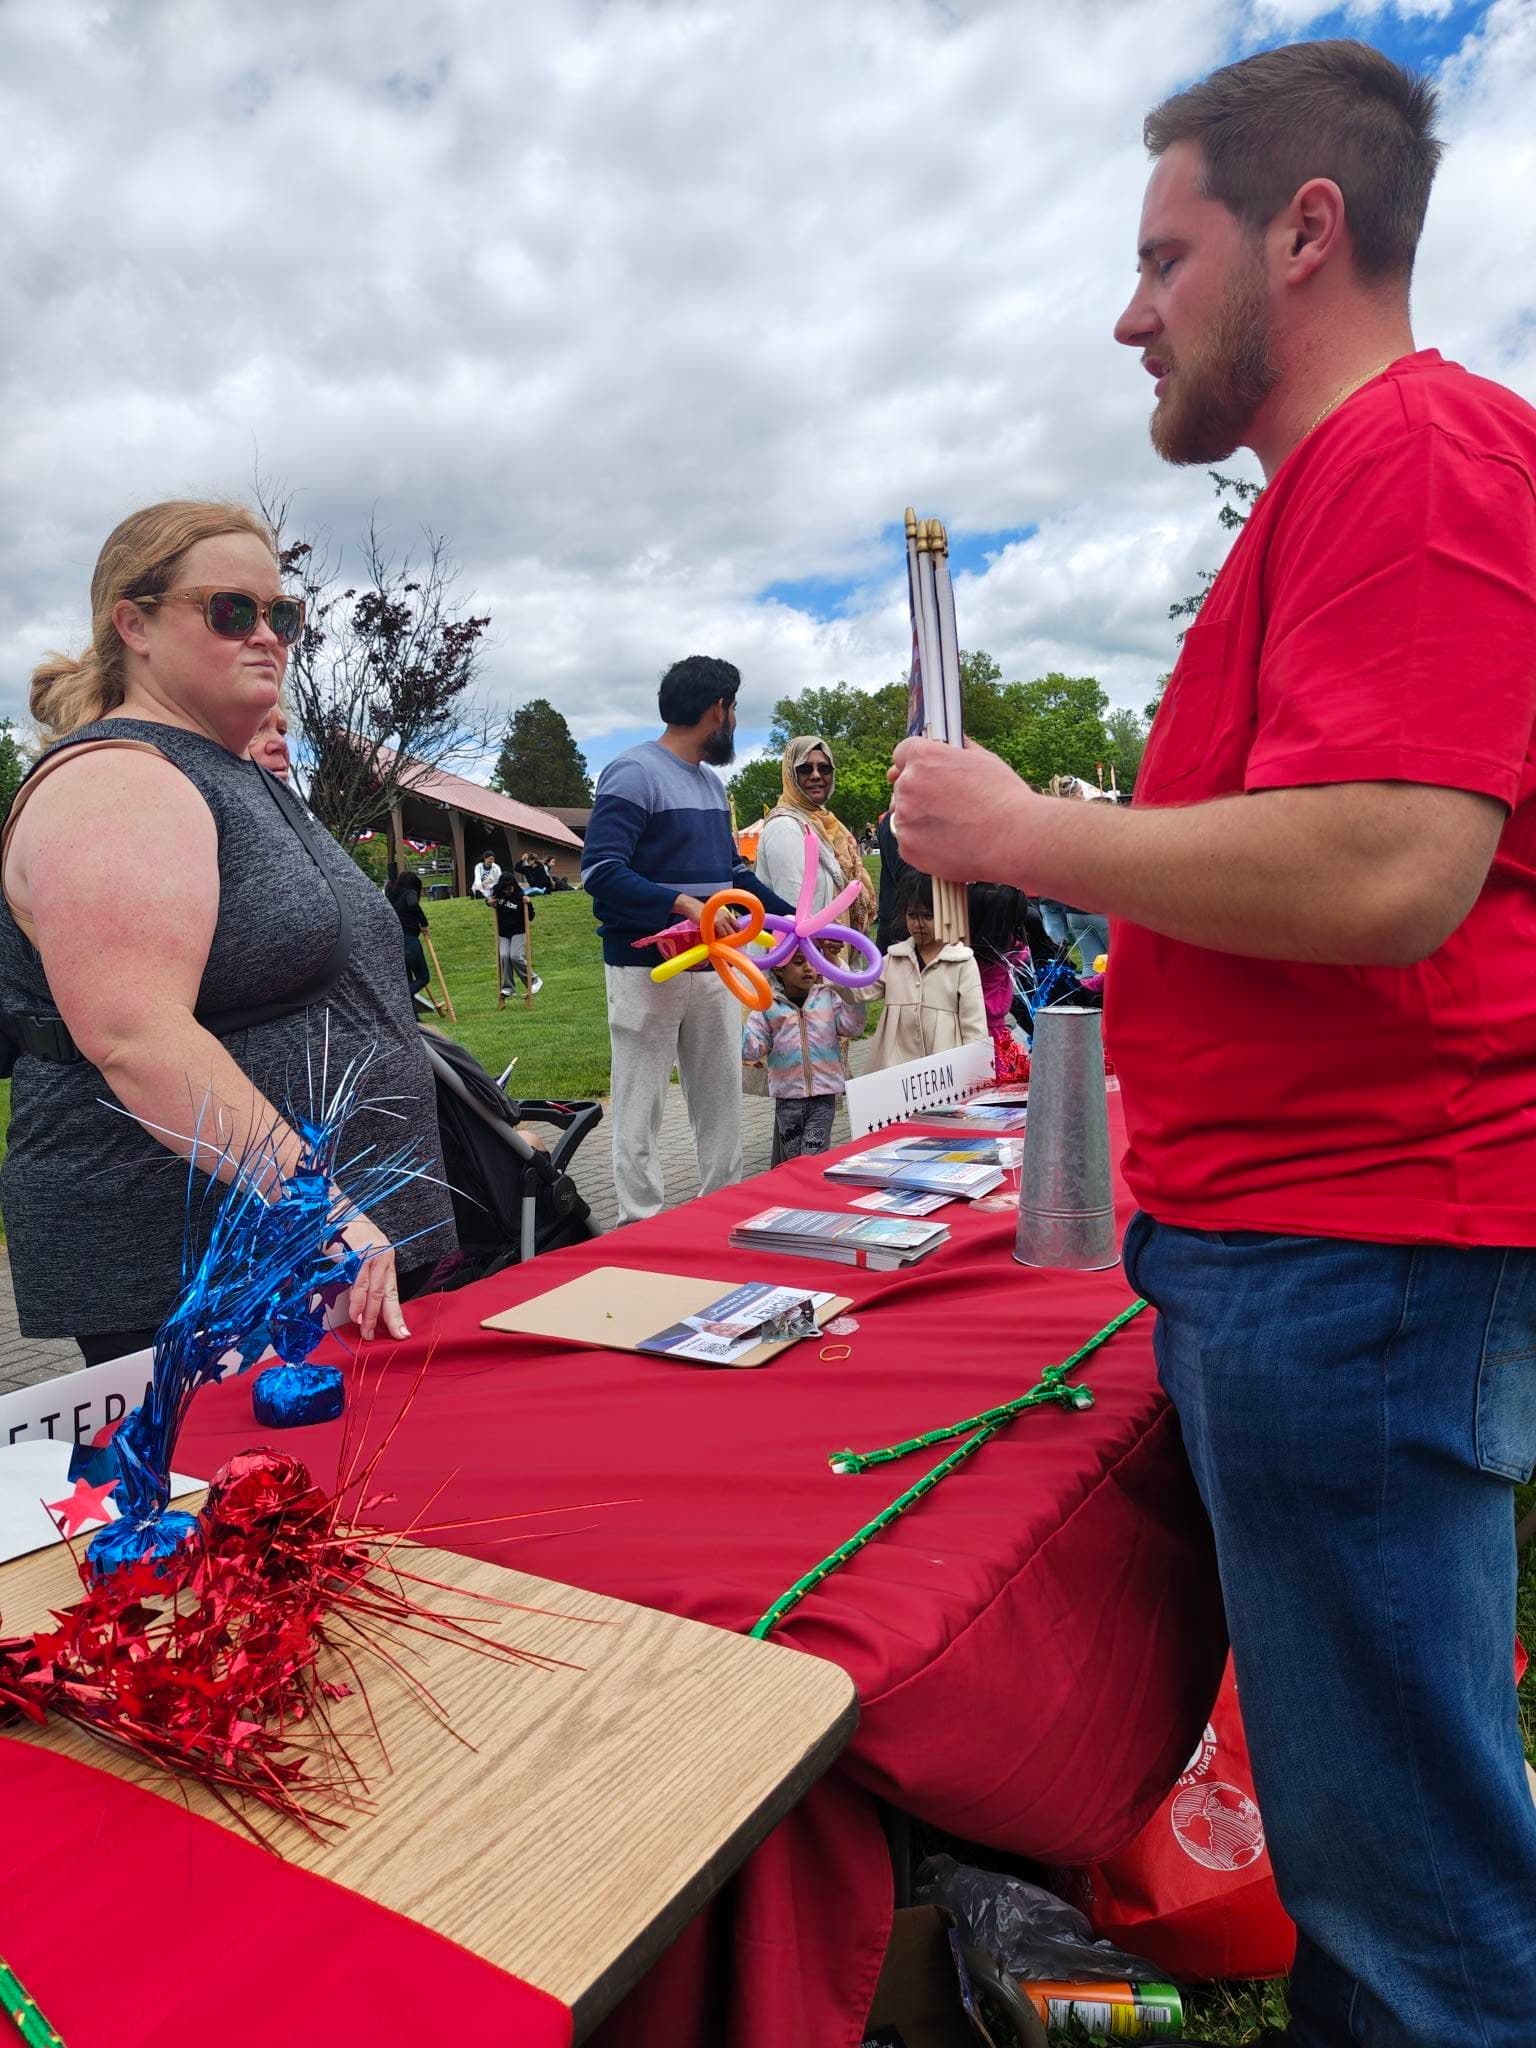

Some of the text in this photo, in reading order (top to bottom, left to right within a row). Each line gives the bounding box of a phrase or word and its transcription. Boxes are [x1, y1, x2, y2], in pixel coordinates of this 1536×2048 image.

[901, 1063, 954, 1103] VETERAN
[9, 1381, 153, 1445] TER
[1176, 1745, 1217, 1787] Earth Fri
